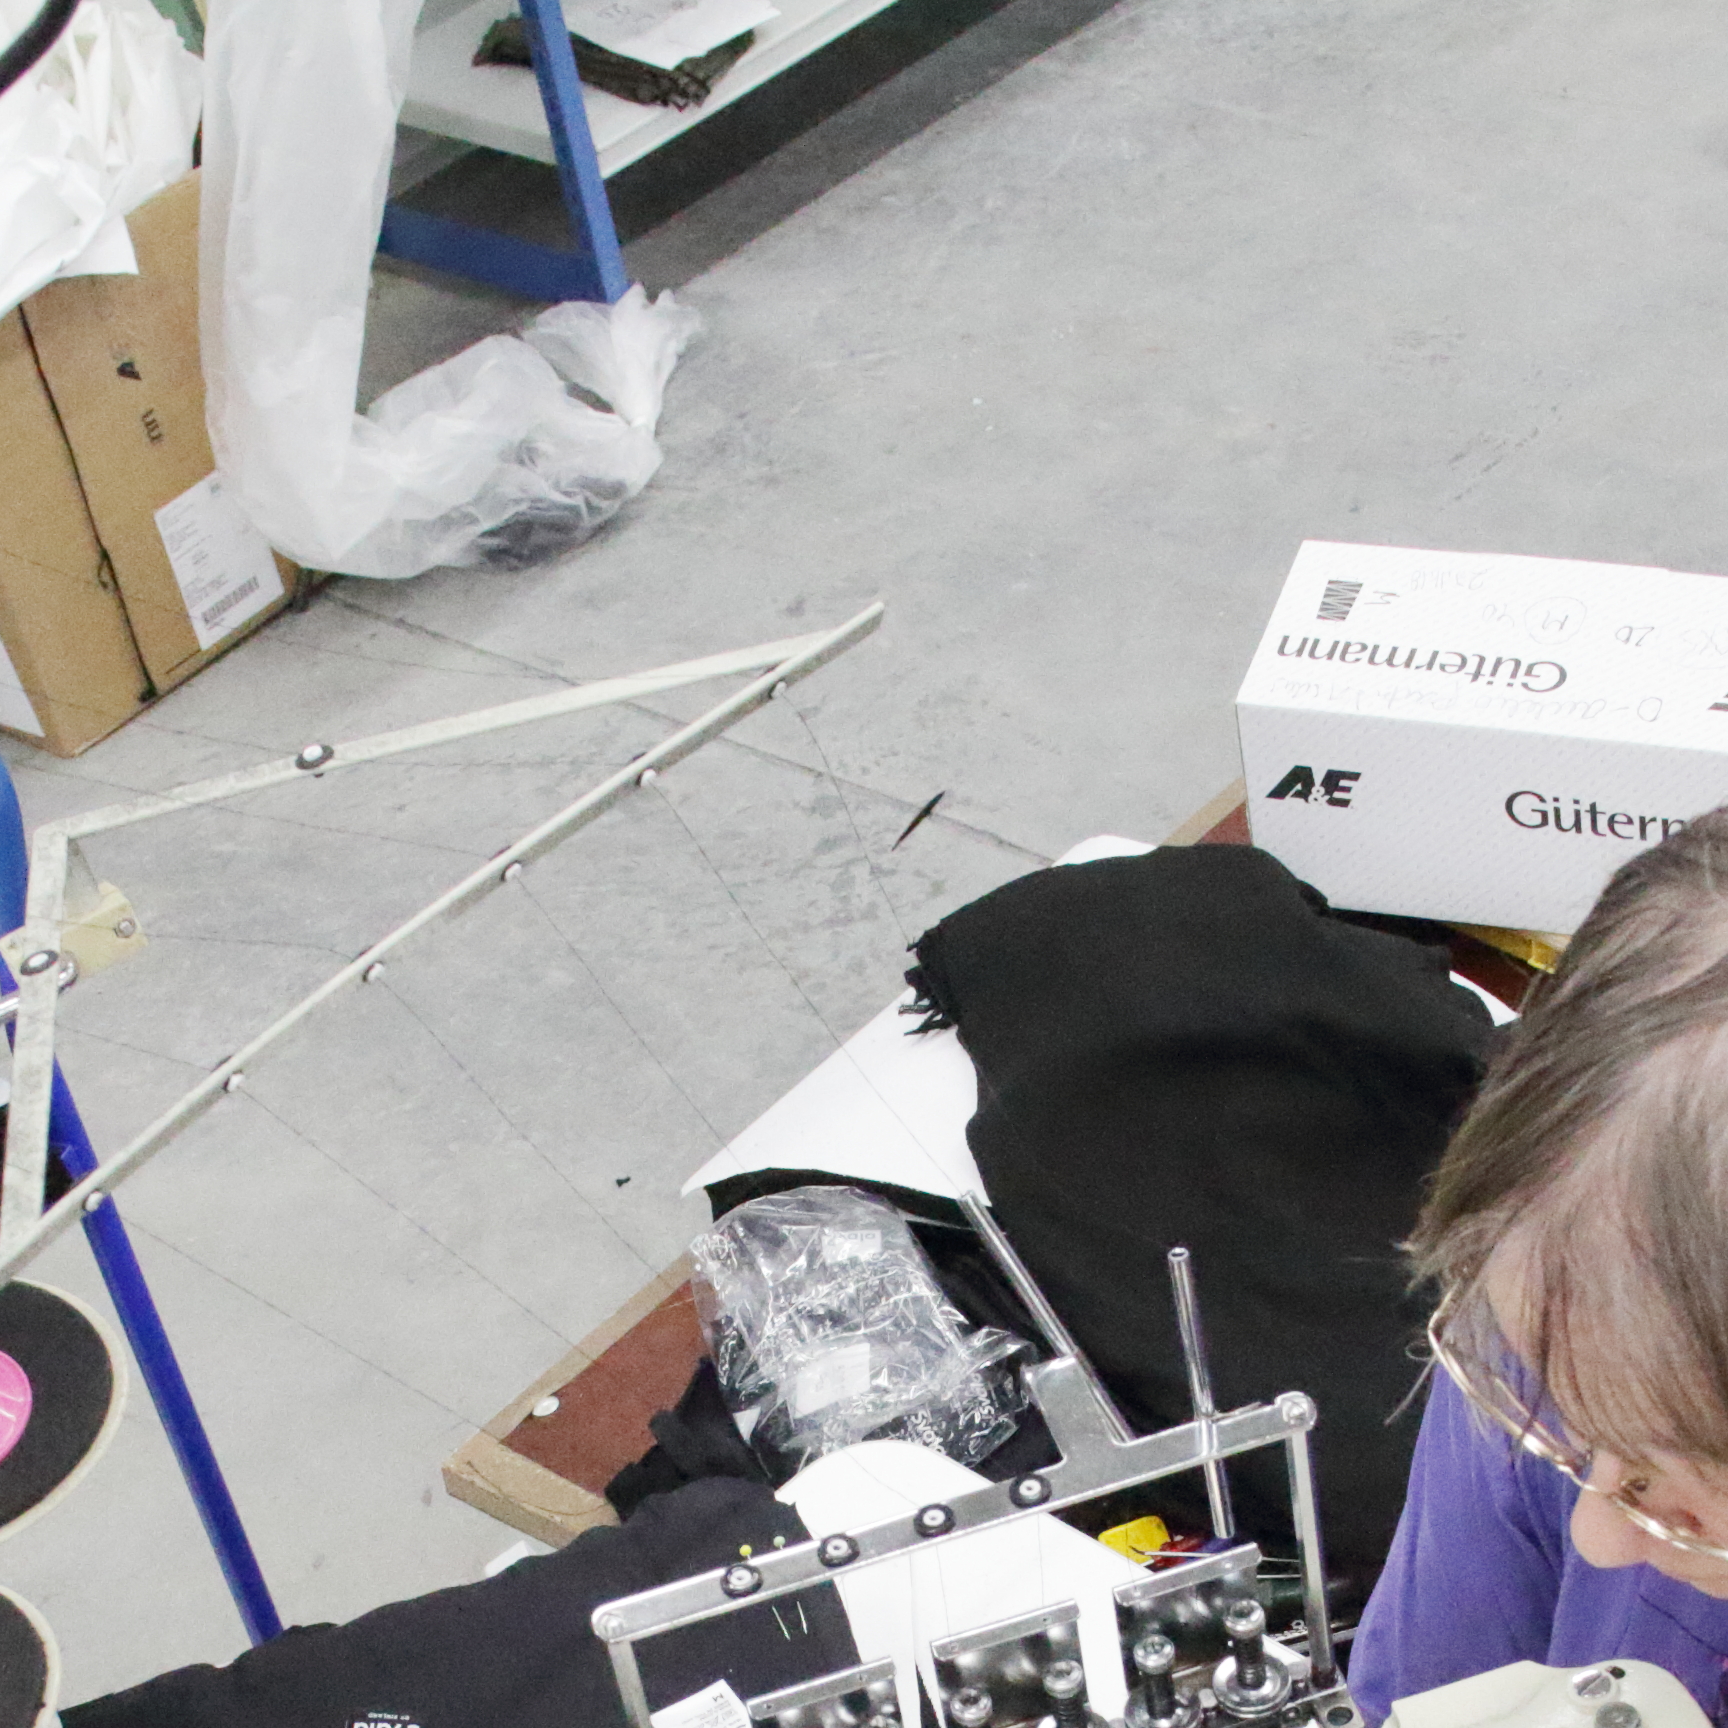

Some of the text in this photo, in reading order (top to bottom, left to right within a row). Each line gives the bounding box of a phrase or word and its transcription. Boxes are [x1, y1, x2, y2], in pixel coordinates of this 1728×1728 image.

[1276, 635, 1567, 693] Gütermann
[1265, 765, 1362, 809] A&E
[1504, 790, 1686, 841] Güter
